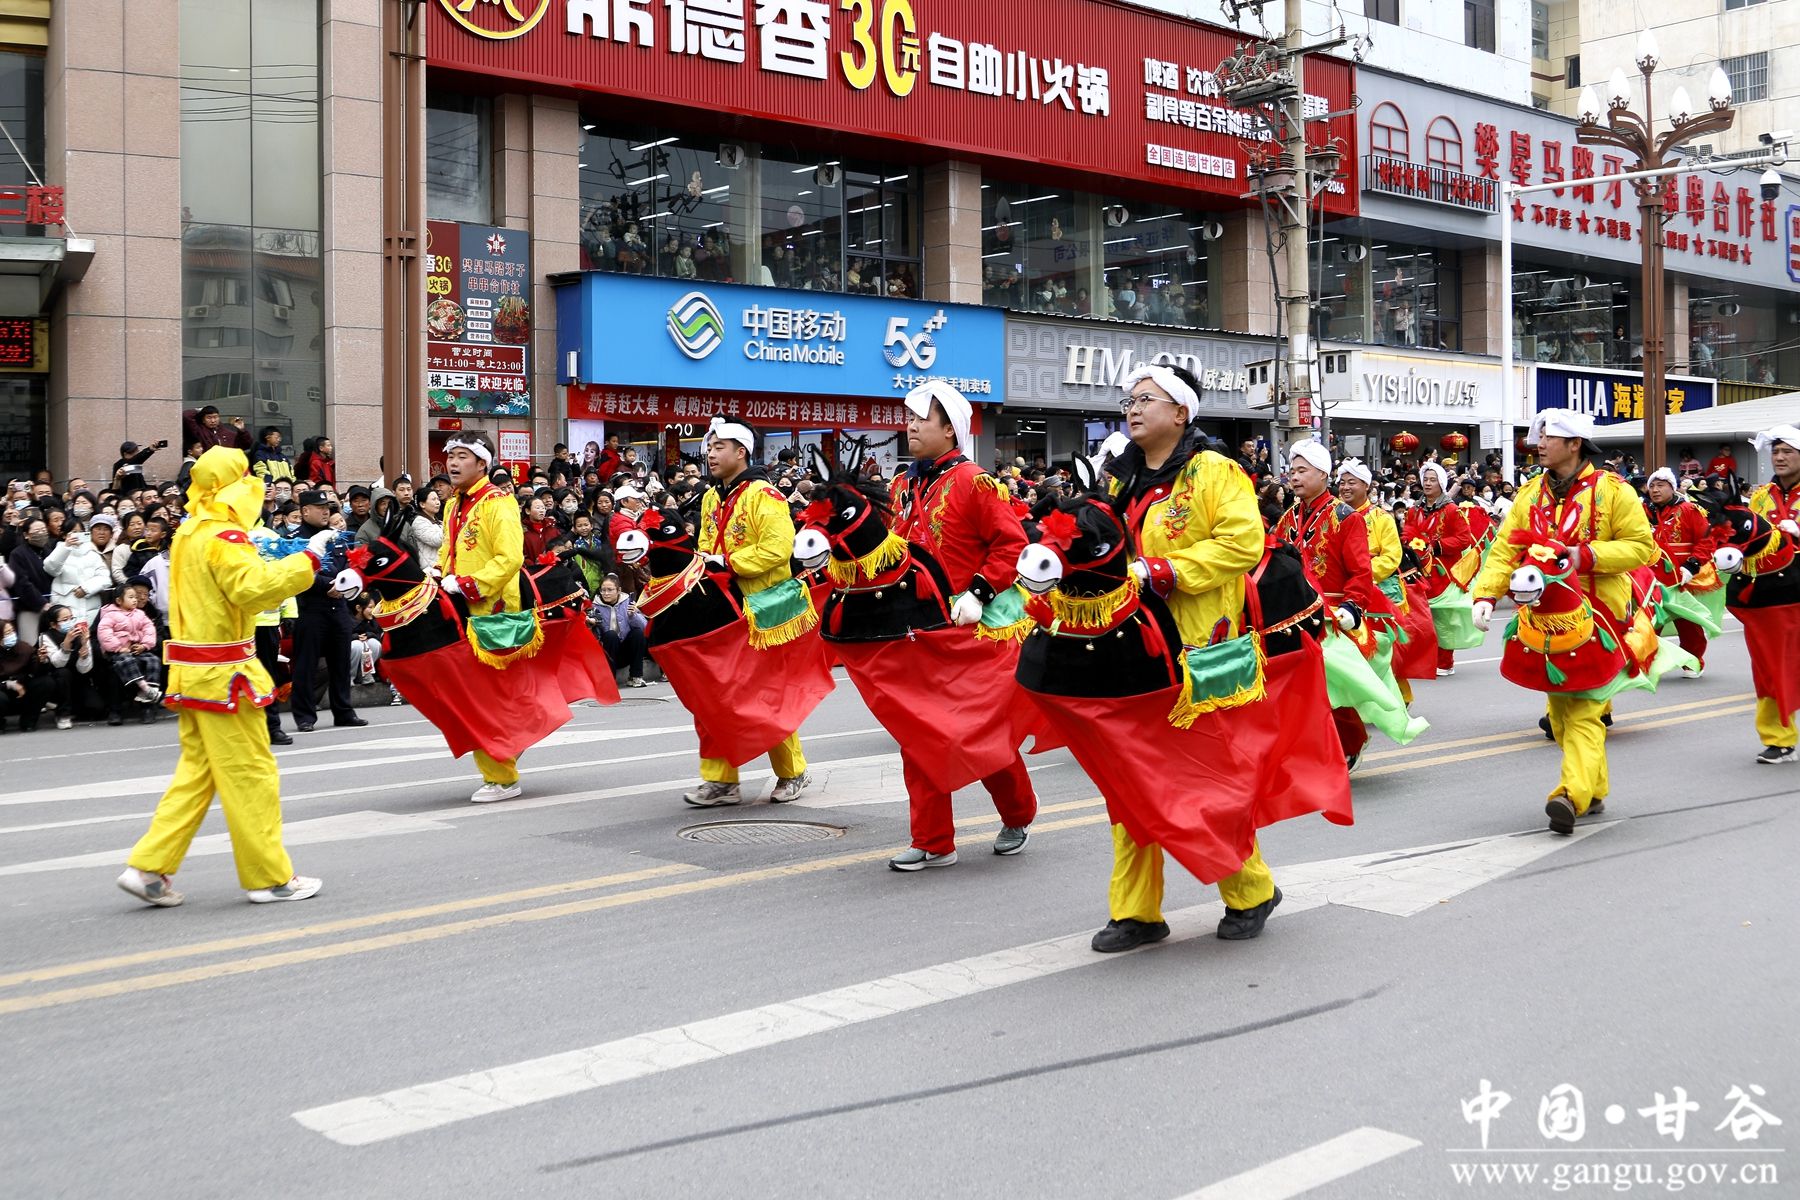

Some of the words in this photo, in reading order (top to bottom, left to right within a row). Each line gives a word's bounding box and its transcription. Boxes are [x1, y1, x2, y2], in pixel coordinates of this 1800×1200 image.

[927, 31, 1110, 117] 自助小火锅
[1144, 57, 1179, 90] 啤酒
[1186, 66, 1220, 99] 饮料
[1148, 146, 1234, 178] 全国连锁甘谷店
[1474, 122, 1777, 241] 樊星马路牙串串合作社
[1663, 229, 1689, 251] 限时
[468, 277, 520, 295] 串串合作社
[742, 304, 846, 342] 中国移动
[451, 347, 493, 358] 营业时间
[428, 374, 476, 389] 梯上二楼
[480, 376, 524, 391] 欢迎光临
[1567, 378, 1608, 417] HLA
[1613, 383, 1685, 418] 海澜家
